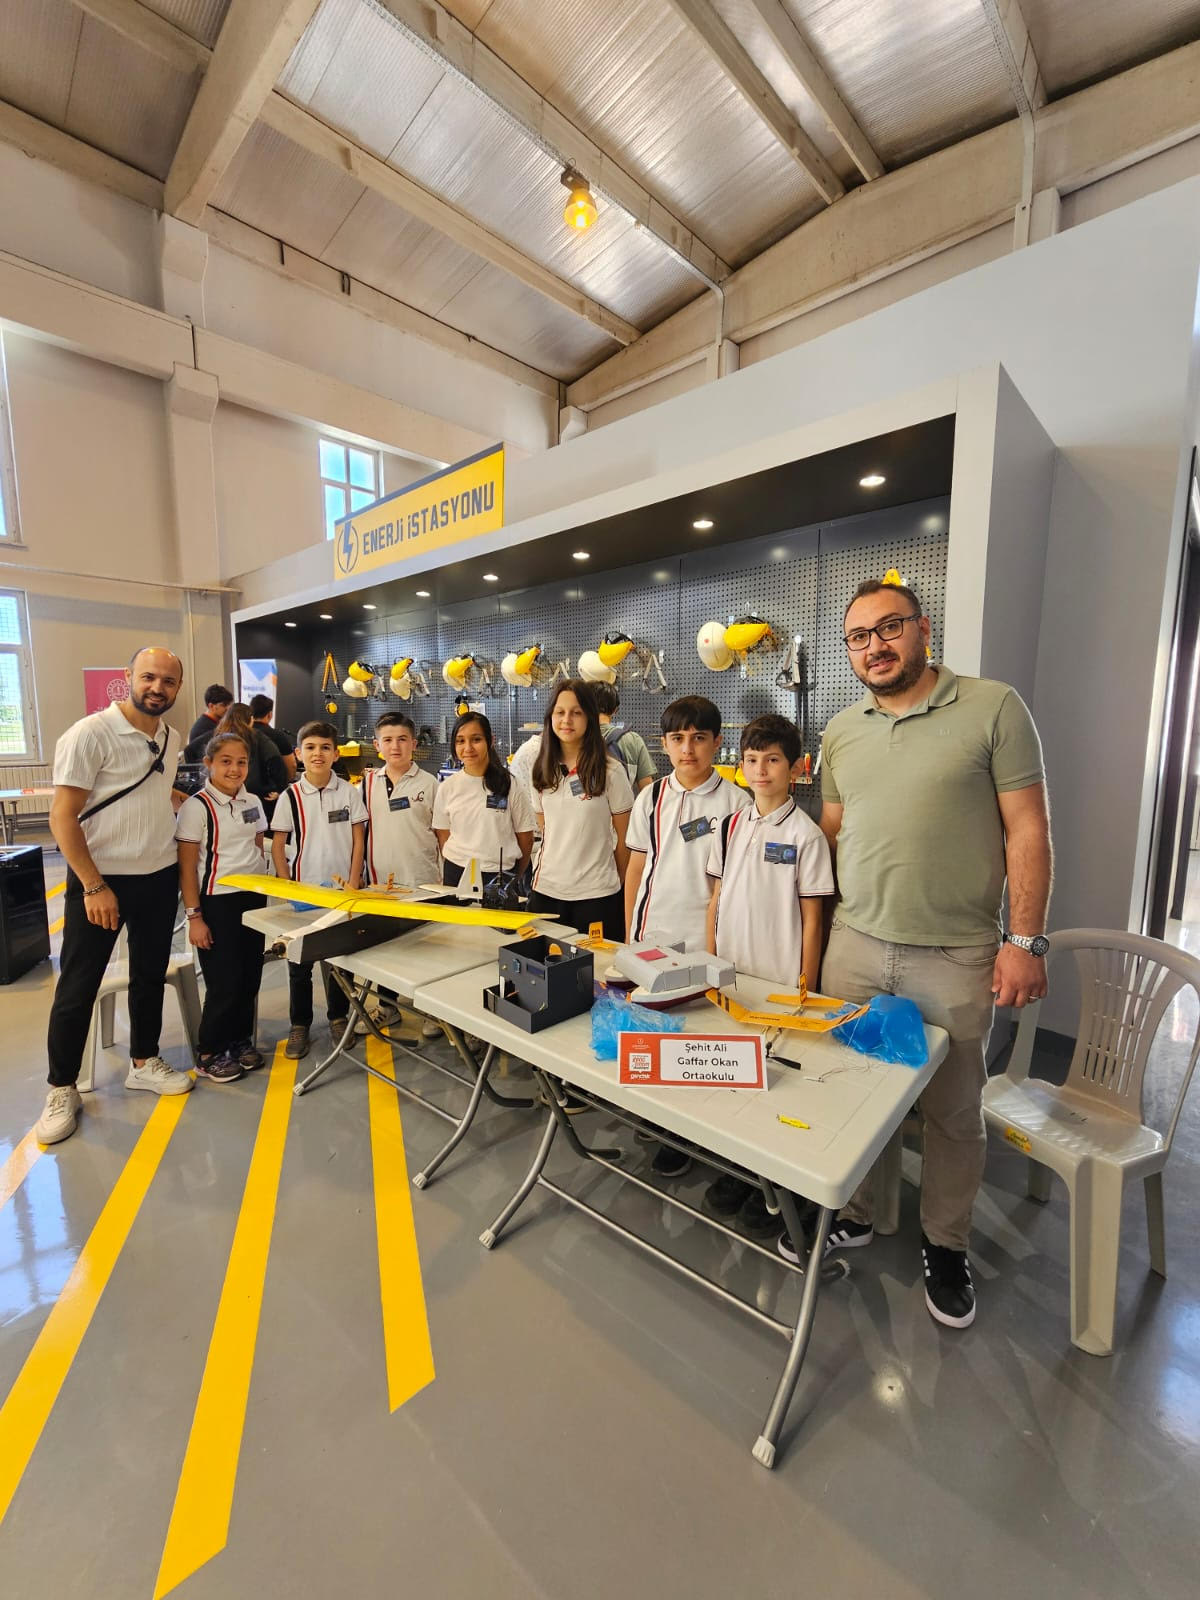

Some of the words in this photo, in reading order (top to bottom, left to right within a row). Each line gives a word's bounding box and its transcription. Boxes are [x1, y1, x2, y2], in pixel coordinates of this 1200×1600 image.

[685, 1043, 711, 1053] Şehit
[714, 1044, 727, 1052] Ali
[677, 1057, 708, 1066] Gaffar
[711, 1058, 739, 1067] Okan
[682, 1071, 735, 1081] Ortaokulu
